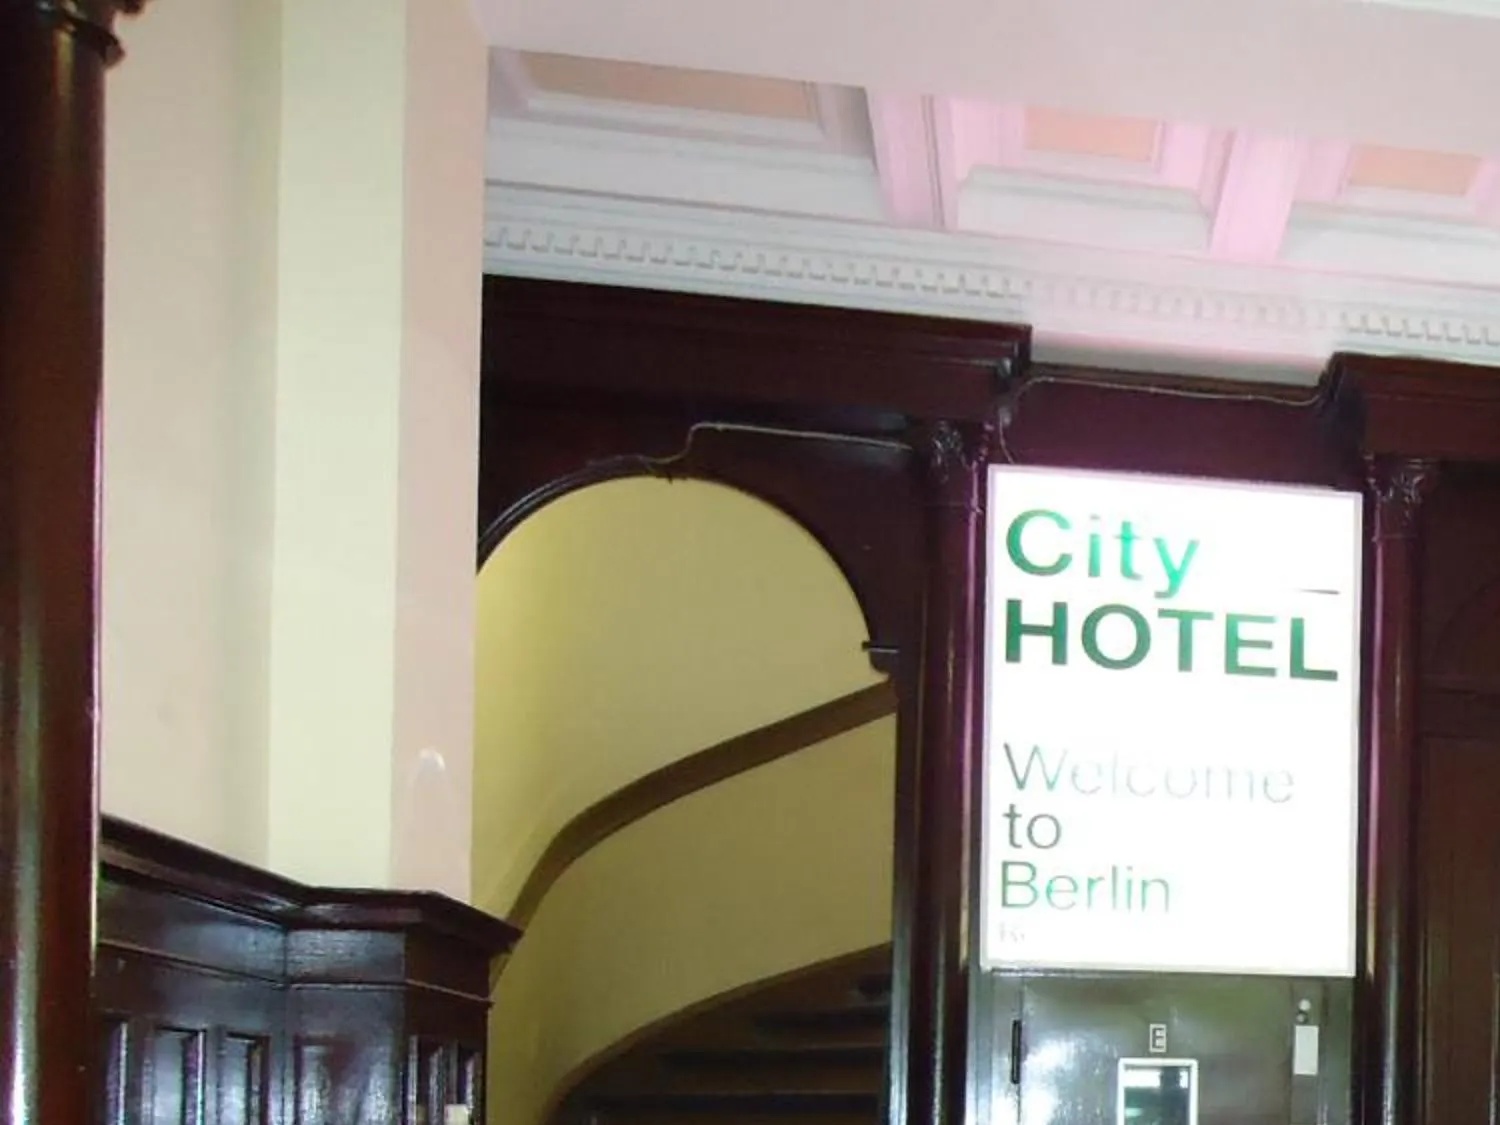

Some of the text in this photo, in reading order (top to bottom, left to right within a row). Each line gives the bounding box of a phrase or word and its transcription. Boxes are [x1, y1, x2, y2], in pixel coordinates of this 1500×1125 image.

[1006, 509, 1200, 599] City
[1005, 598, 1339, 682] HOTEL
[1003, 742, 1295, 804] Welcome
[1002, 803, 1062, 850] to
[1000, 859, 1170, 914] Berlin
[1152, 1027, 1165, 1049] E
